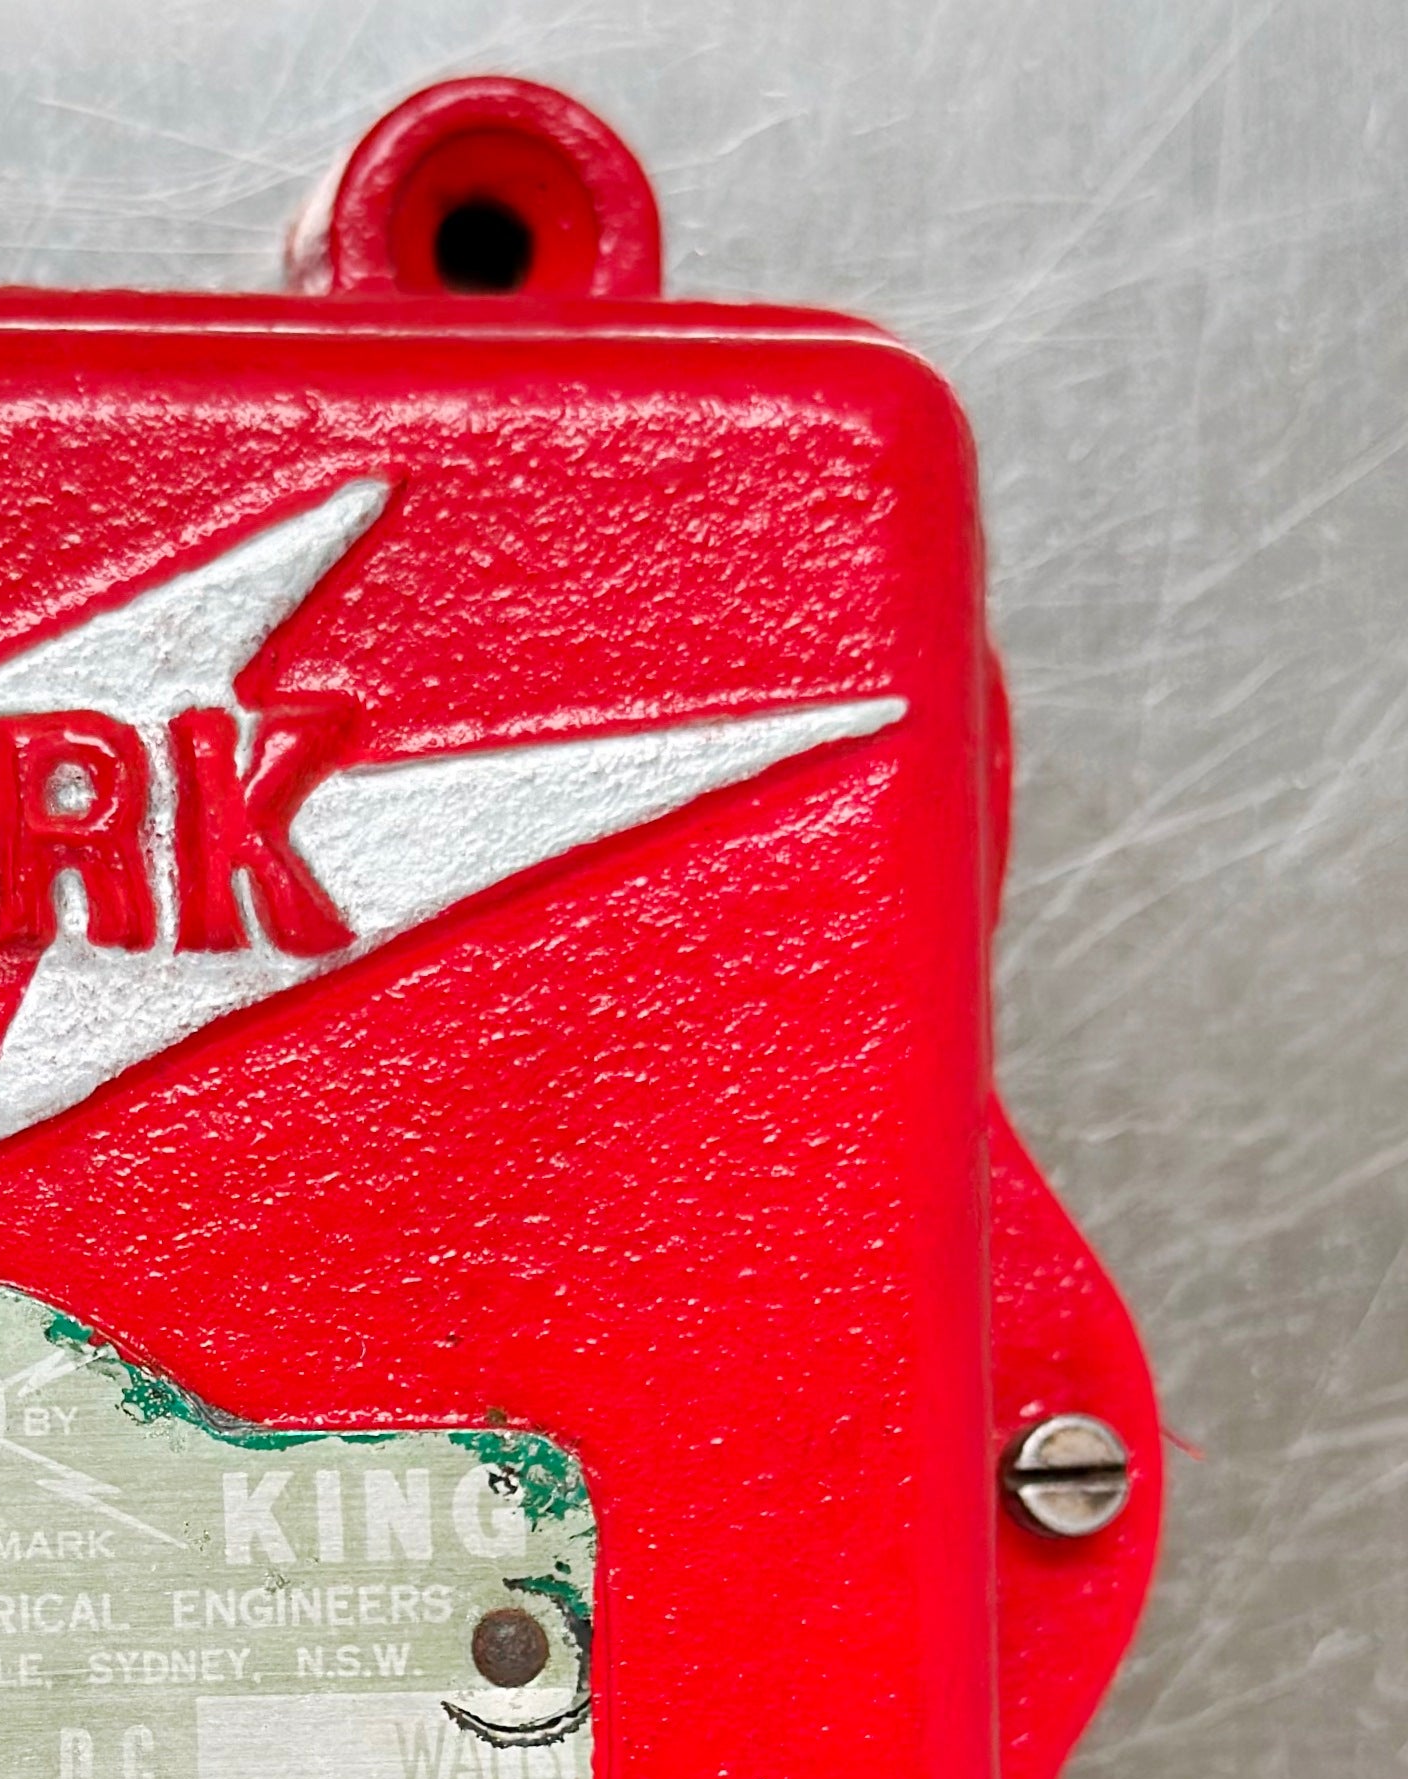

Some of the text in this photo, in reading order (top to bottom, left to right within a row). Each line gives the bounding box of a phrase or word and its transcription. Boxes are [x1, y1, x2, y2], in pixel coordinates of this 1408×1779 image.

[22, 1405, 79, 1438] BY
[221, 1466, 528, 1566] KING
[171, 1582, 454, 1629] ENGINEERS
[86, 1646, 263, 1684] SYDNEY,
[295, 1641, 424, 1679] N.S.W.
